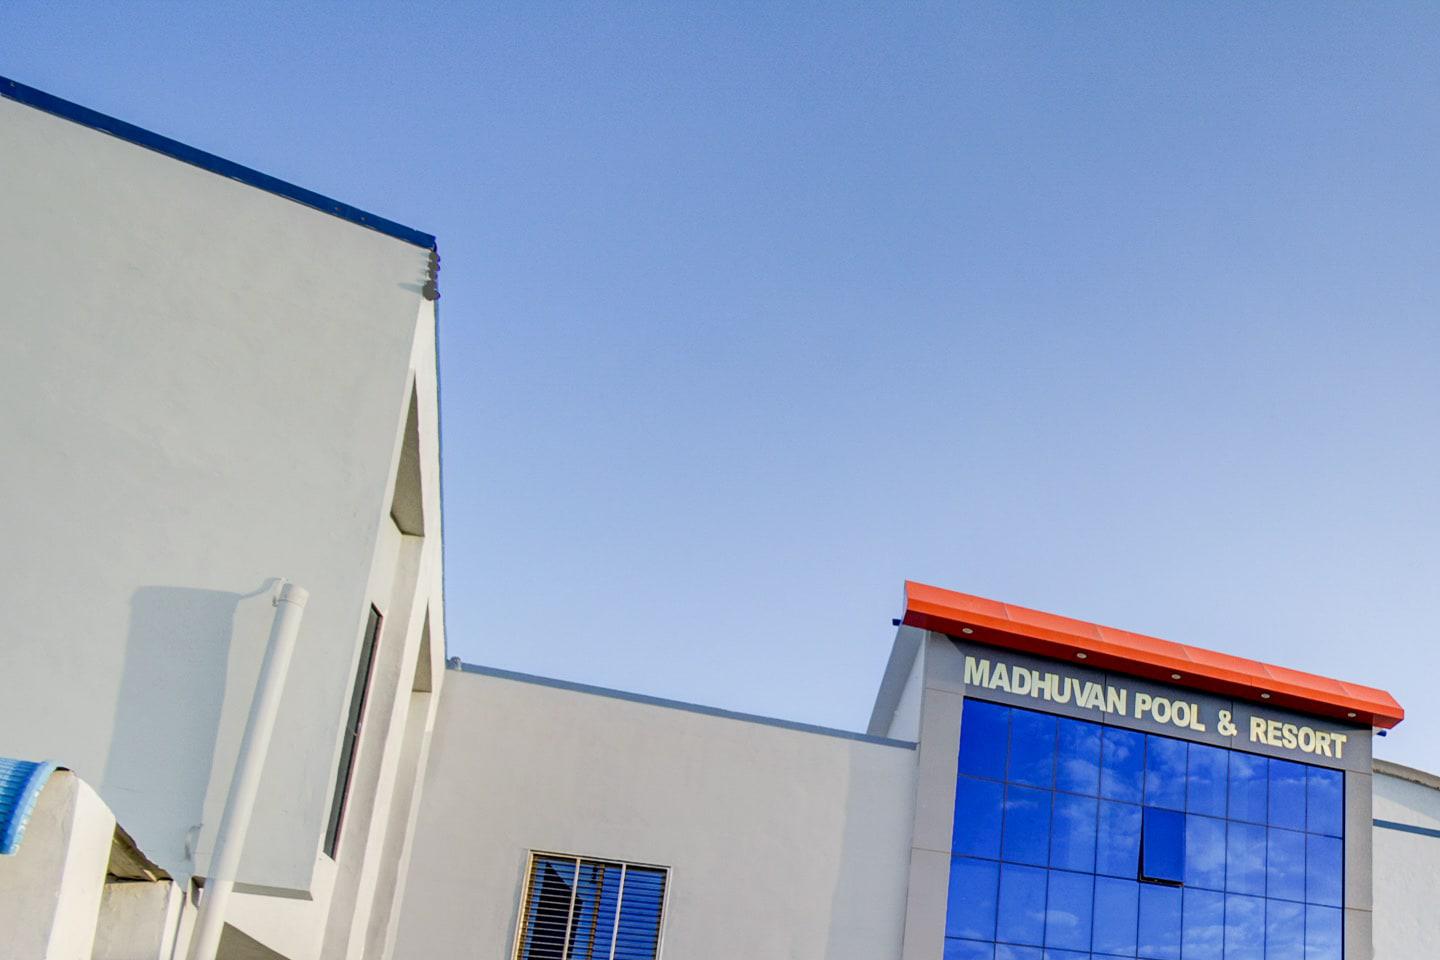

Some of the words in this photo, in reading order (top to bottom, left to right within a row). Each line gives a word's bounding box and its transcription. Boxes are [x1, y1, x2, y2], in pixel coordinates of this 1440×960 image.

[964, 656, 1127, 716] MADHUVAN
[1135, 692, 1206, 732] POOL
[1218, 709, 1238, 737] &
[1250, 716, 1348, 759] RESORT
